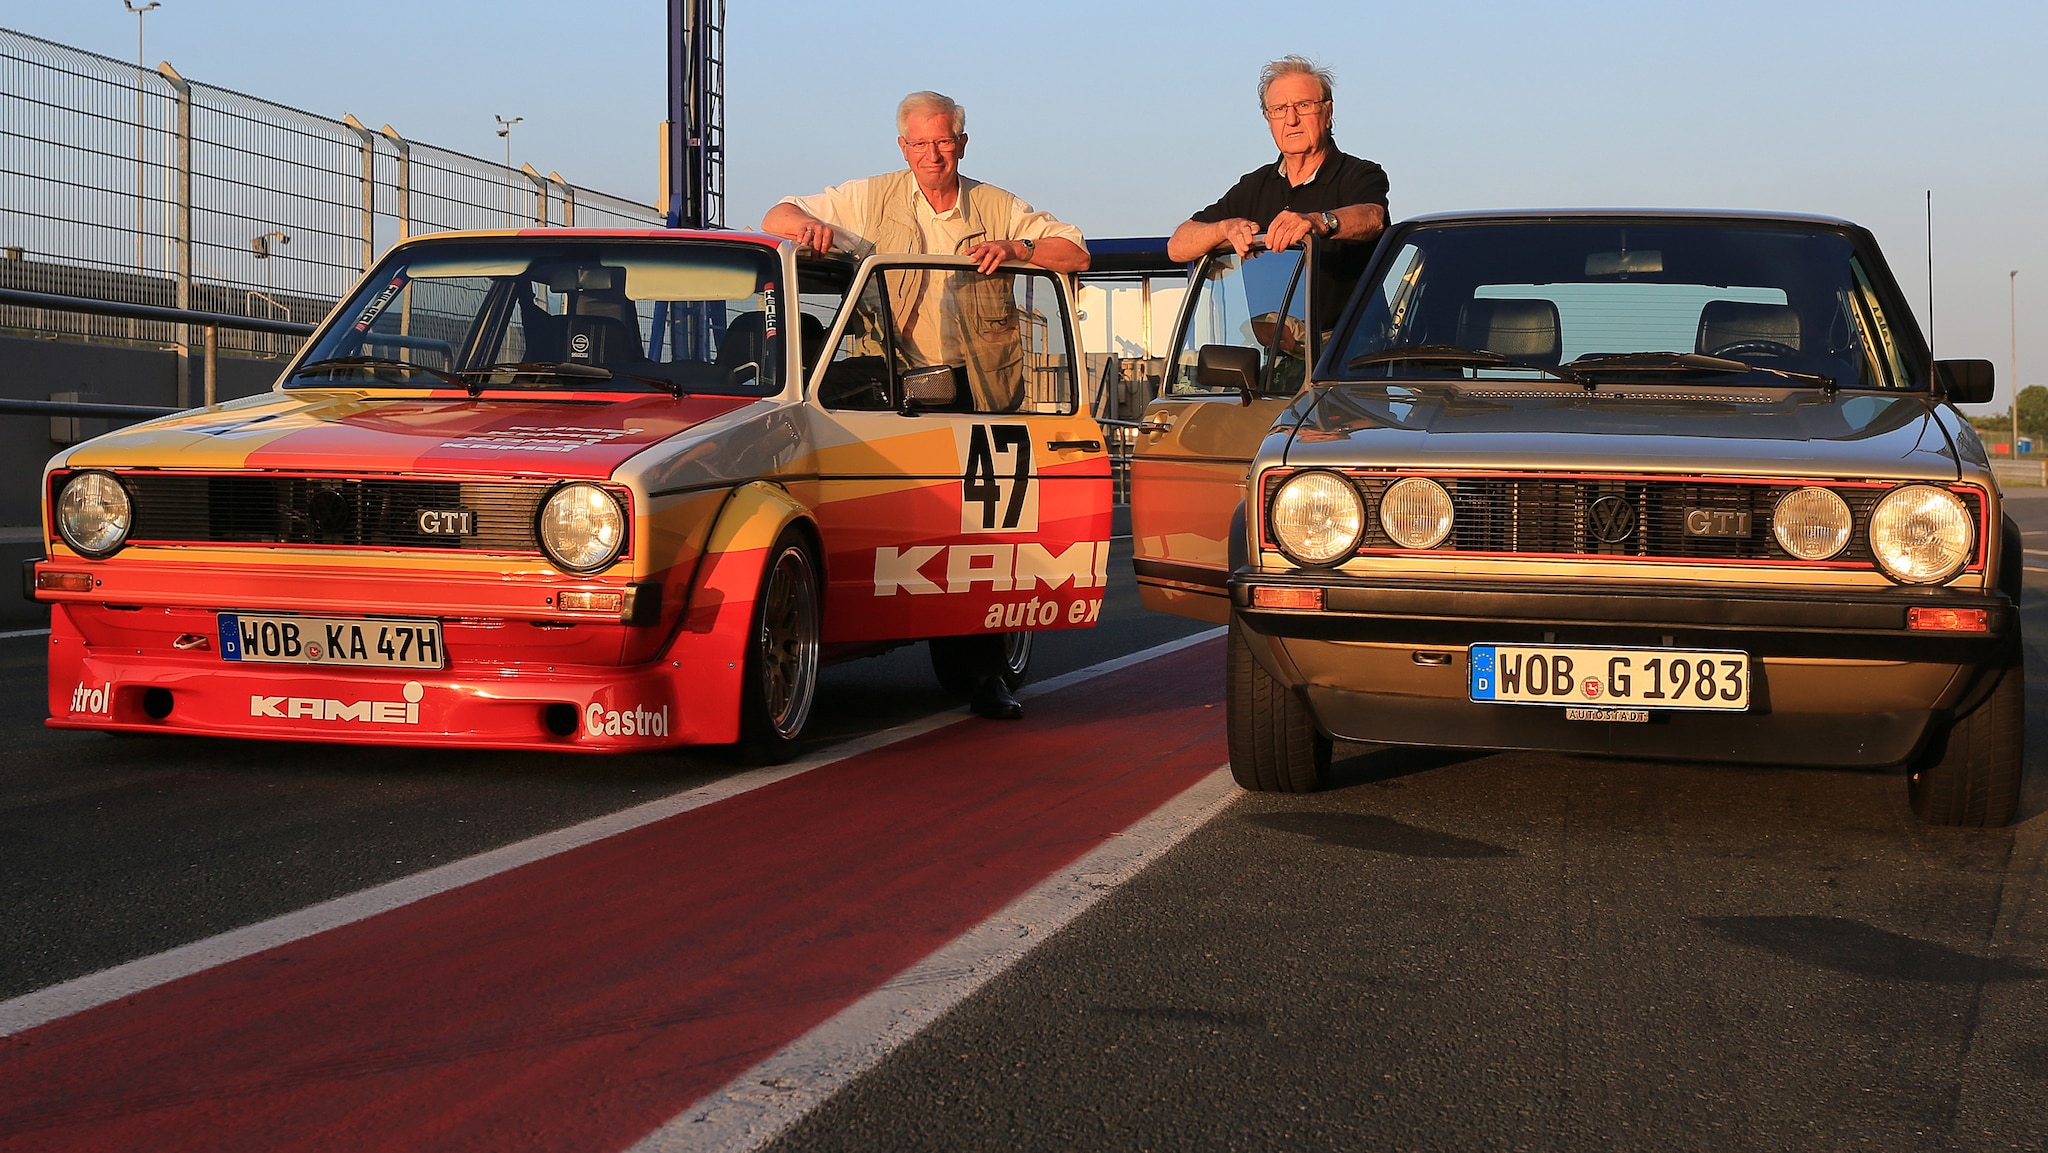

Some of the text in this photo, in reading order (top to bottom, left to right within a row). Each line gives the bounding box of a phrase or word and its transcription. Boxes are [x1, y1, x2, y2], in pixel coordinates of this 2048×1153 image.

[964, 424, 1031, 529] 47
[420, 511, 469, 534] GTI
[1687, 510, 1747, 535] GTI
[984, 596, 1059, 628] auto
[227, 620, 438, 663] D WOB KA 47H
[1478, 678, 1488, 691] D
[1500, 653, 1575, 696] WOB
[1608, 656, 1631, 698] G
[1643, 658, 1743, 701] 1983
[586, 702, 669, 737] Castrol
[1569, 710, 1645, 721] AUTOSTADT
